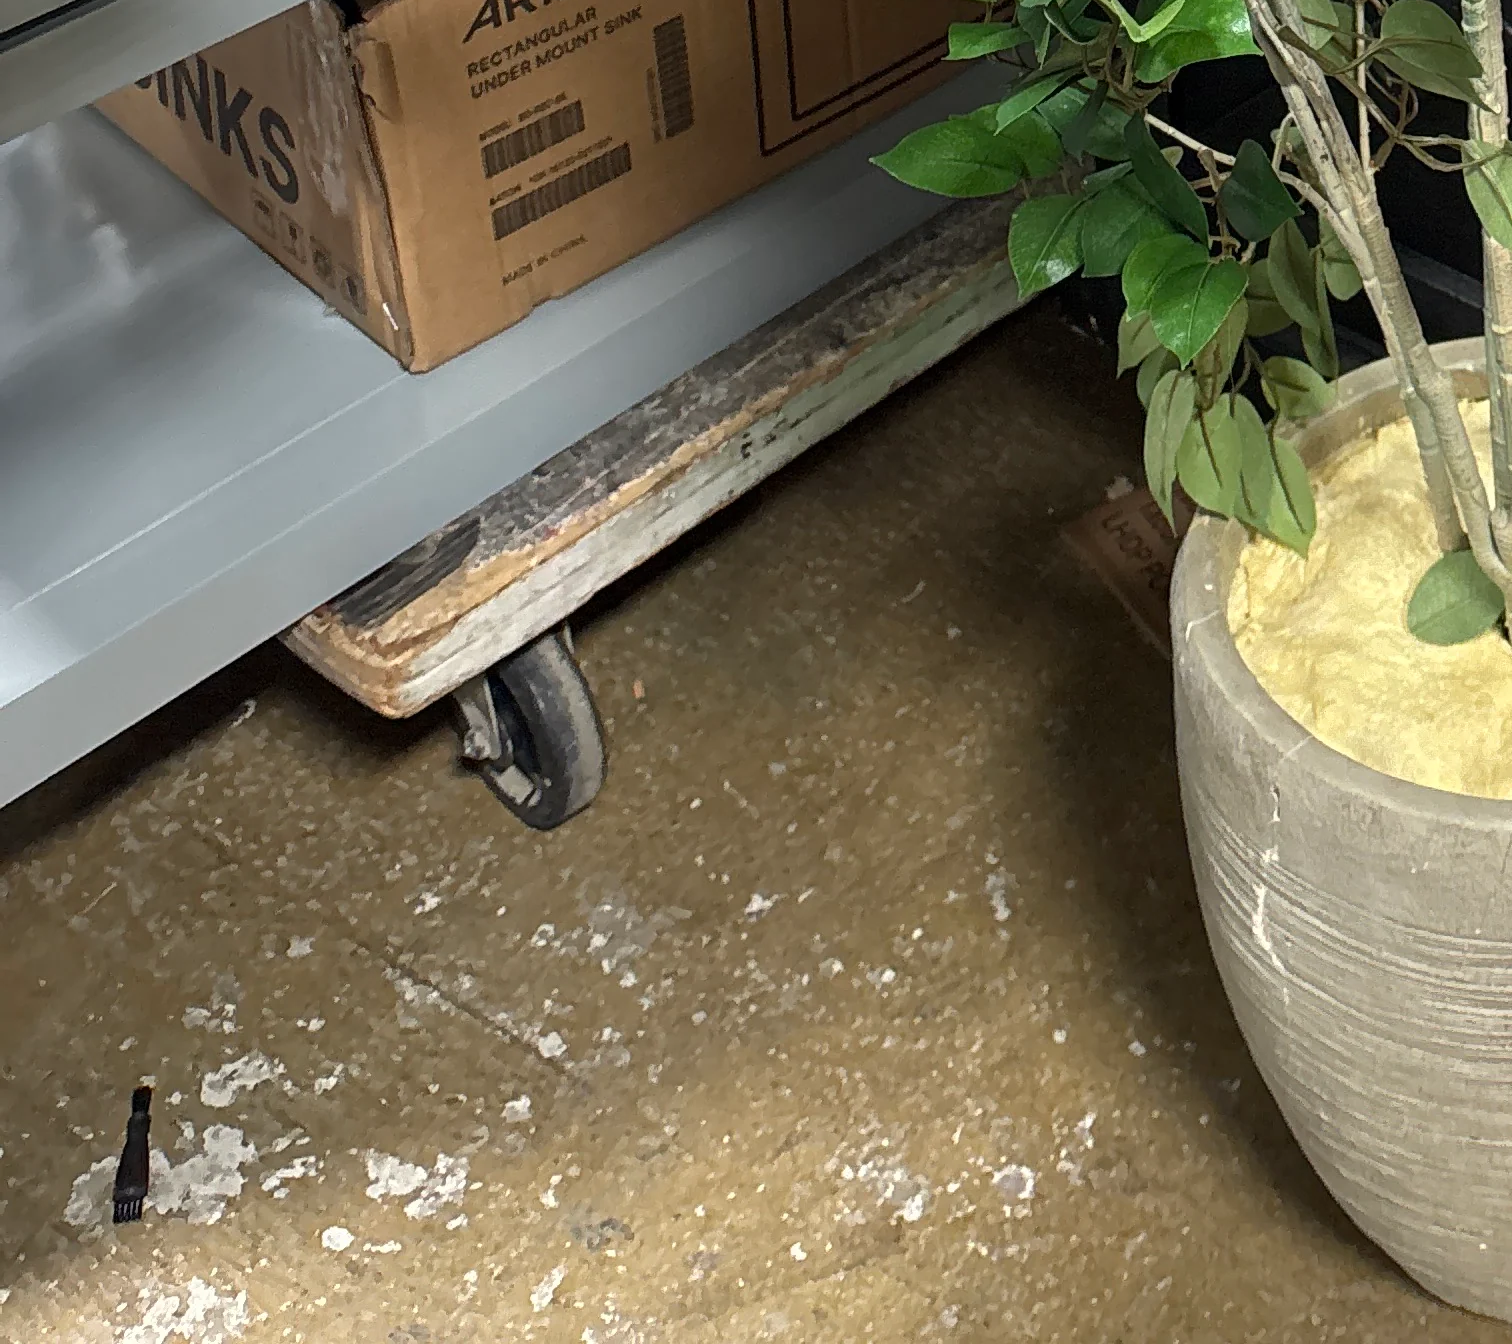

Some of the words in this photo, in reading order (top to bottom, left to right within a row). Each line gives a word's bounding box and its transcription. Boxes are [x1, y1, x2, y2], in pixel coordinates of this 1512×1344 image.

[466, 5, 598, 79] RECTANGULAR
[470, 59, 532, 99] UNDER
[535, 25, 600, 69] MOUNT
[603, 5, 643, 36] SINK
[134, 52, 299, 204] NKS
